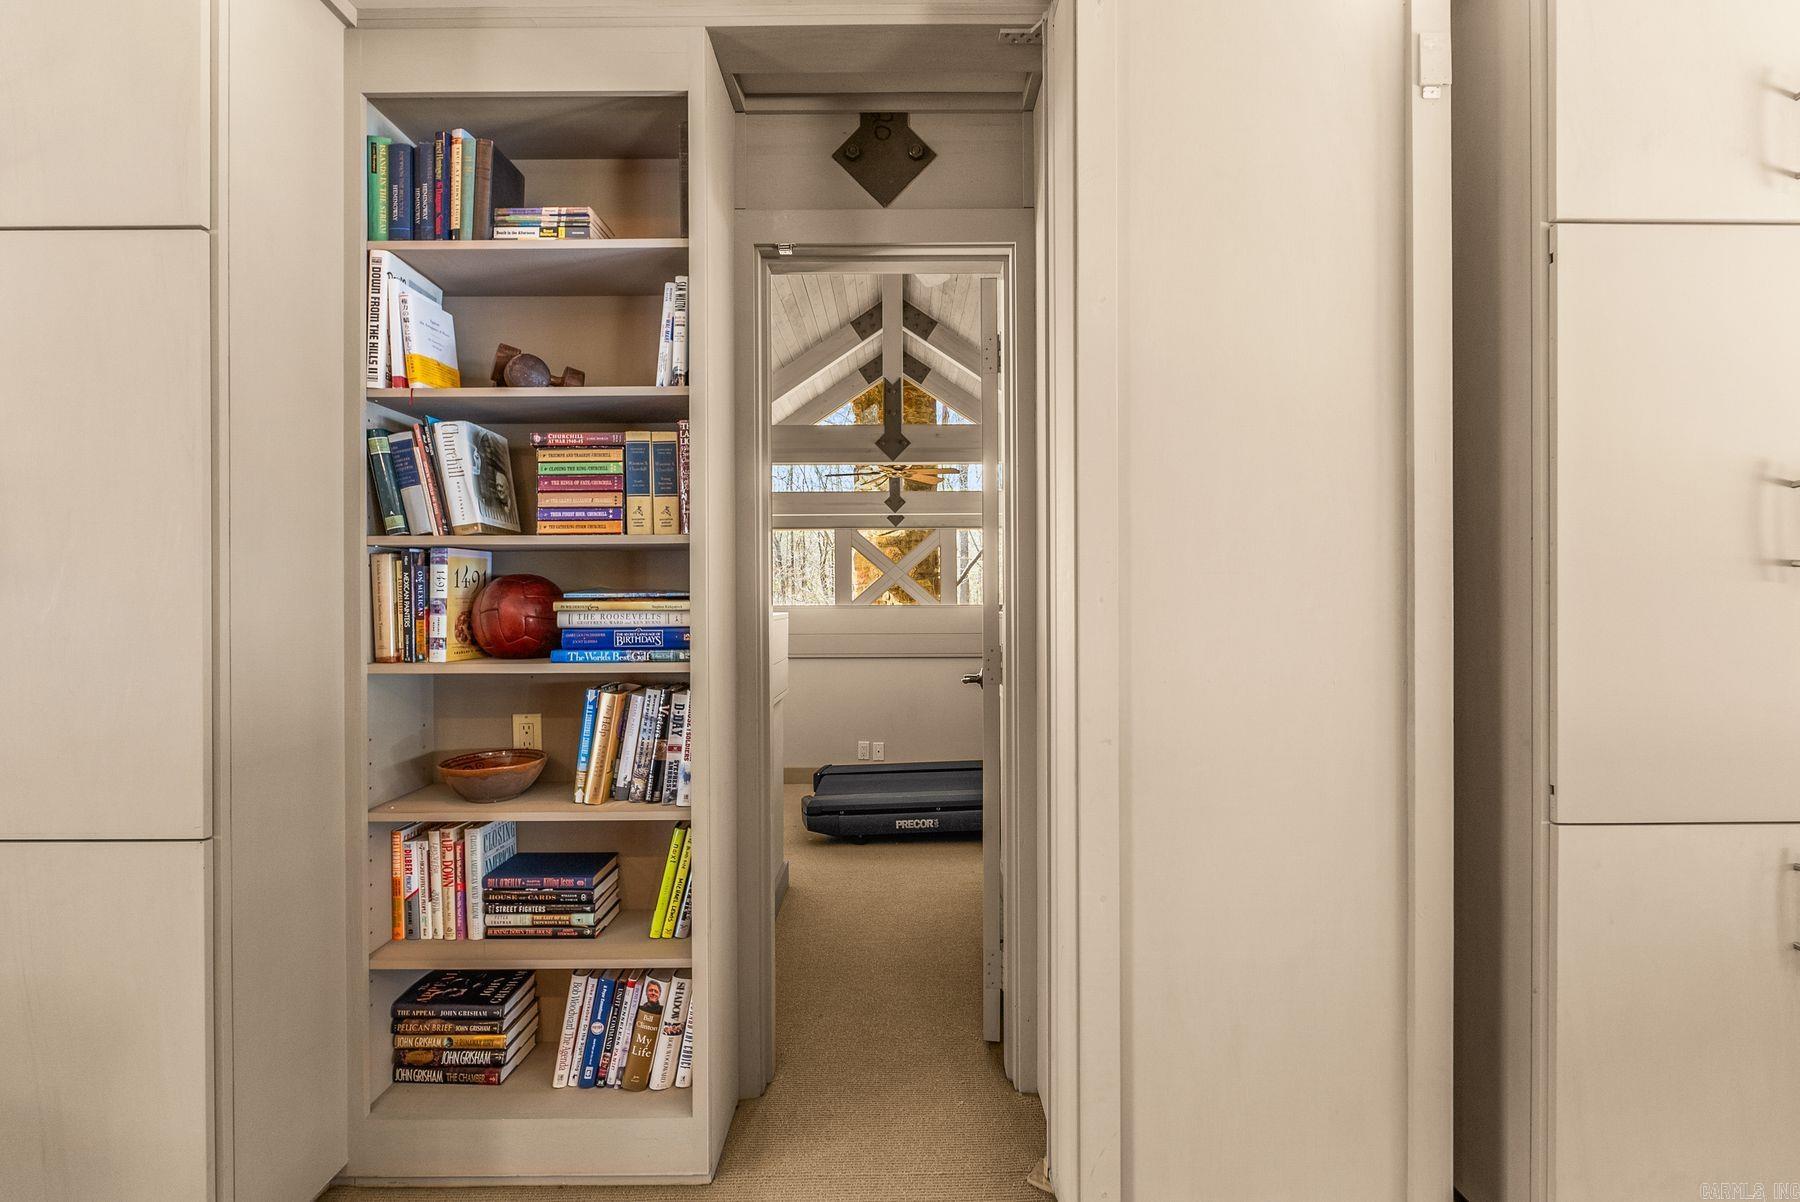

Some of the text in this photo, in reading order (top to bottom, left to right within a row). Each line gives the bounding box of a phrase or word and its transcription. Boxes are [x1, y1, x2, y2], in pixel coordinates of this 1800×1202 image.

[371, 266, 382, 294] DOWN
[675, 282, 686, 312] SAM WALTON
[370, 296, 381, 322] FROM
[369, 324, 380, 339] THE
[664, 319, 672, 343] WAL-MART
[368, 342, 378, 365] HILLS
[440, 423, 466, 479] Churchill
[418, 570, 424, 582] ON
[434, 570, 446, 592] 1491
[616, 635, 661, 646] BIRTHDAYS
[568, 651, 585, 661] The
[586, 651, 611, 661] World's
[612, 651, 629, 661] Best
[599, 716, 611, 737] Help
[637, 694, 651, 769] STEPHEN AMBROSE
[656, 705, 670, 738] Victors
[672, 704, 685, 737] D-DAY
[896, 819, 934, 829] PRECOR
[404, 850, 412, 875] DILBERT
[442, 840, 454, 888] UP DOWN
[670, 844, 678, 863] next
[488, 878, 498, 888] BILL
[560, 878, 574, 886] Jesus
[614, 988, 623, 1007] UNFIT
[671, 982, 685, 1022] SHADOW
[584, 997, 593, 1021] Huckabee
[558, 982, 582, 1071] Bob Woodward The Agenda
[606, 1016, 617, 1050] COMMAND
[637, 1021, 657, 1031] Clinton
[397, 1037, 442, 1048] JOHN GRISHAM
[636, 1033, 652, 1047] My
[441, 1051, 459, 1064] JOHN
[460, 1051, 491, 1064] GRISHAM
[632, 1046, 652, 1058] Life
[680, 1046, 692, 1069] CHOICE
[395, 1069, 486, 1082] JOHN GRISHAM THE CHAMBER
[660, 1050, 672, 1083] WOODWARD
